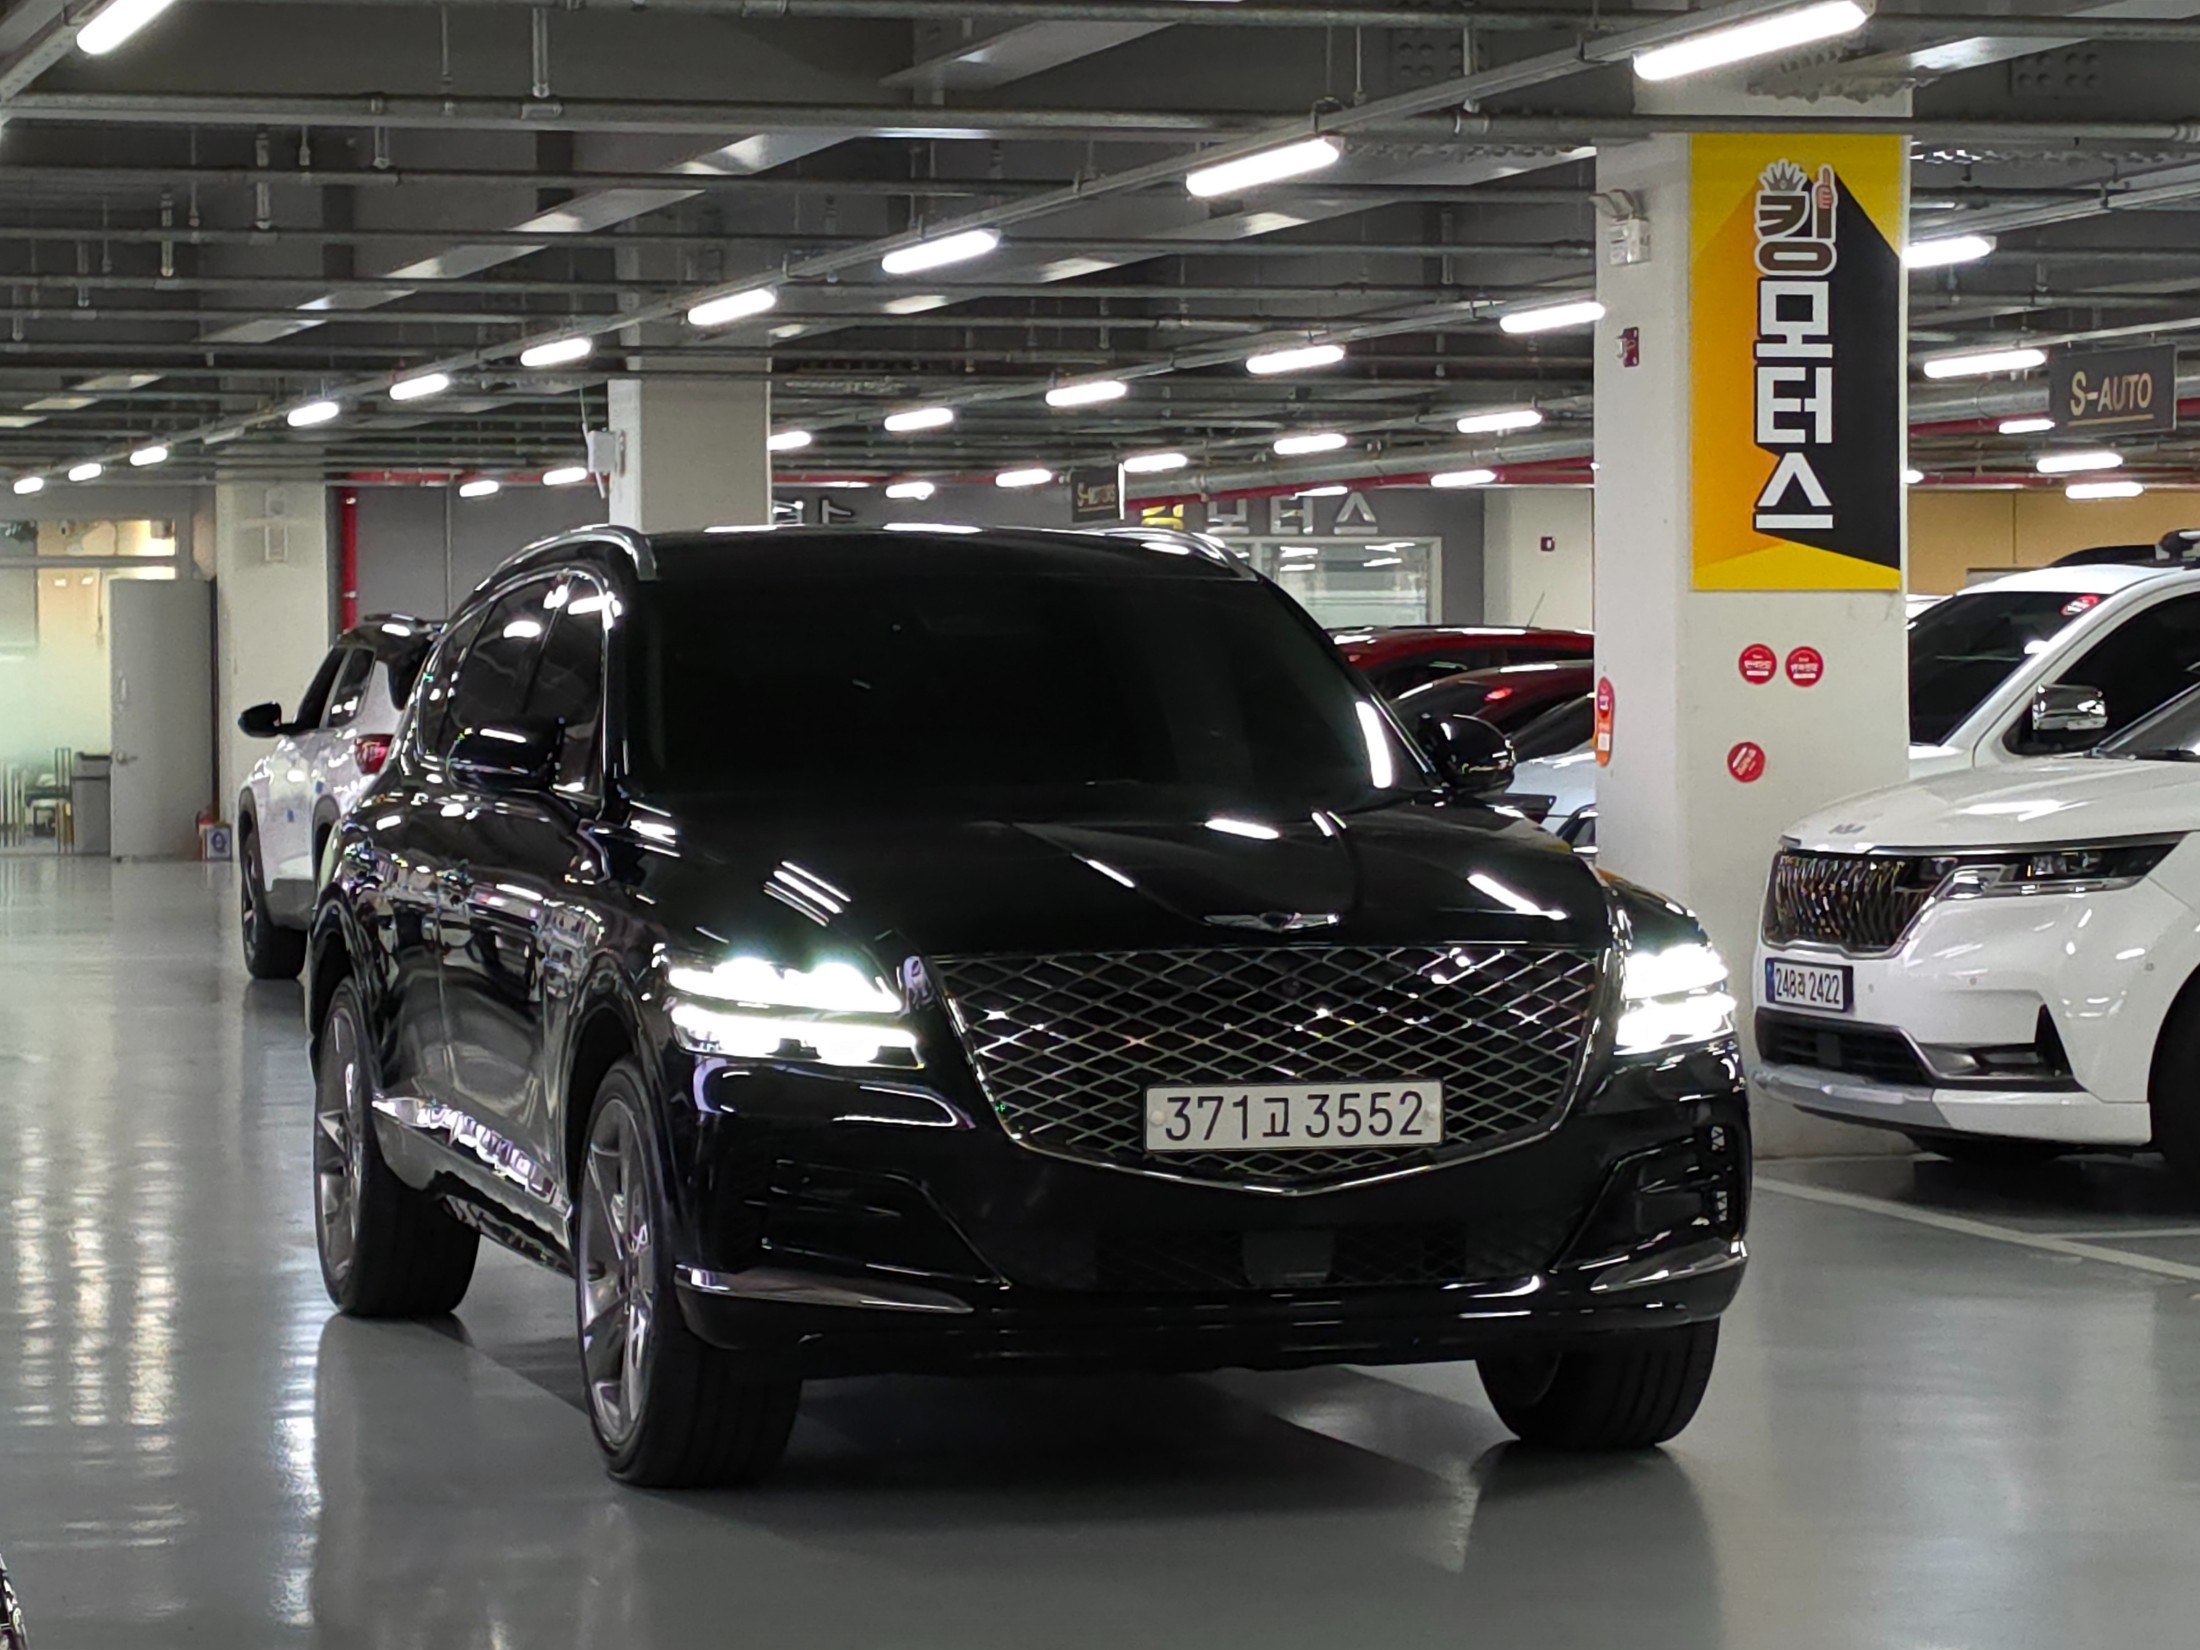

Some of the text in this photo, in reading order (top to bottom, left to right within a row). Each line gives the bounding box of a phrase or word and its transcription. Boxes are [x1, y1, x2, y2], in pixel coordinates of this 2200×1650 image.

[1755, 160, 1837, 529] 킹모터스
[2070, 371, 2152, 416] S-AUTO
[1165, 1090, 1423, 1141] 371고 3552
